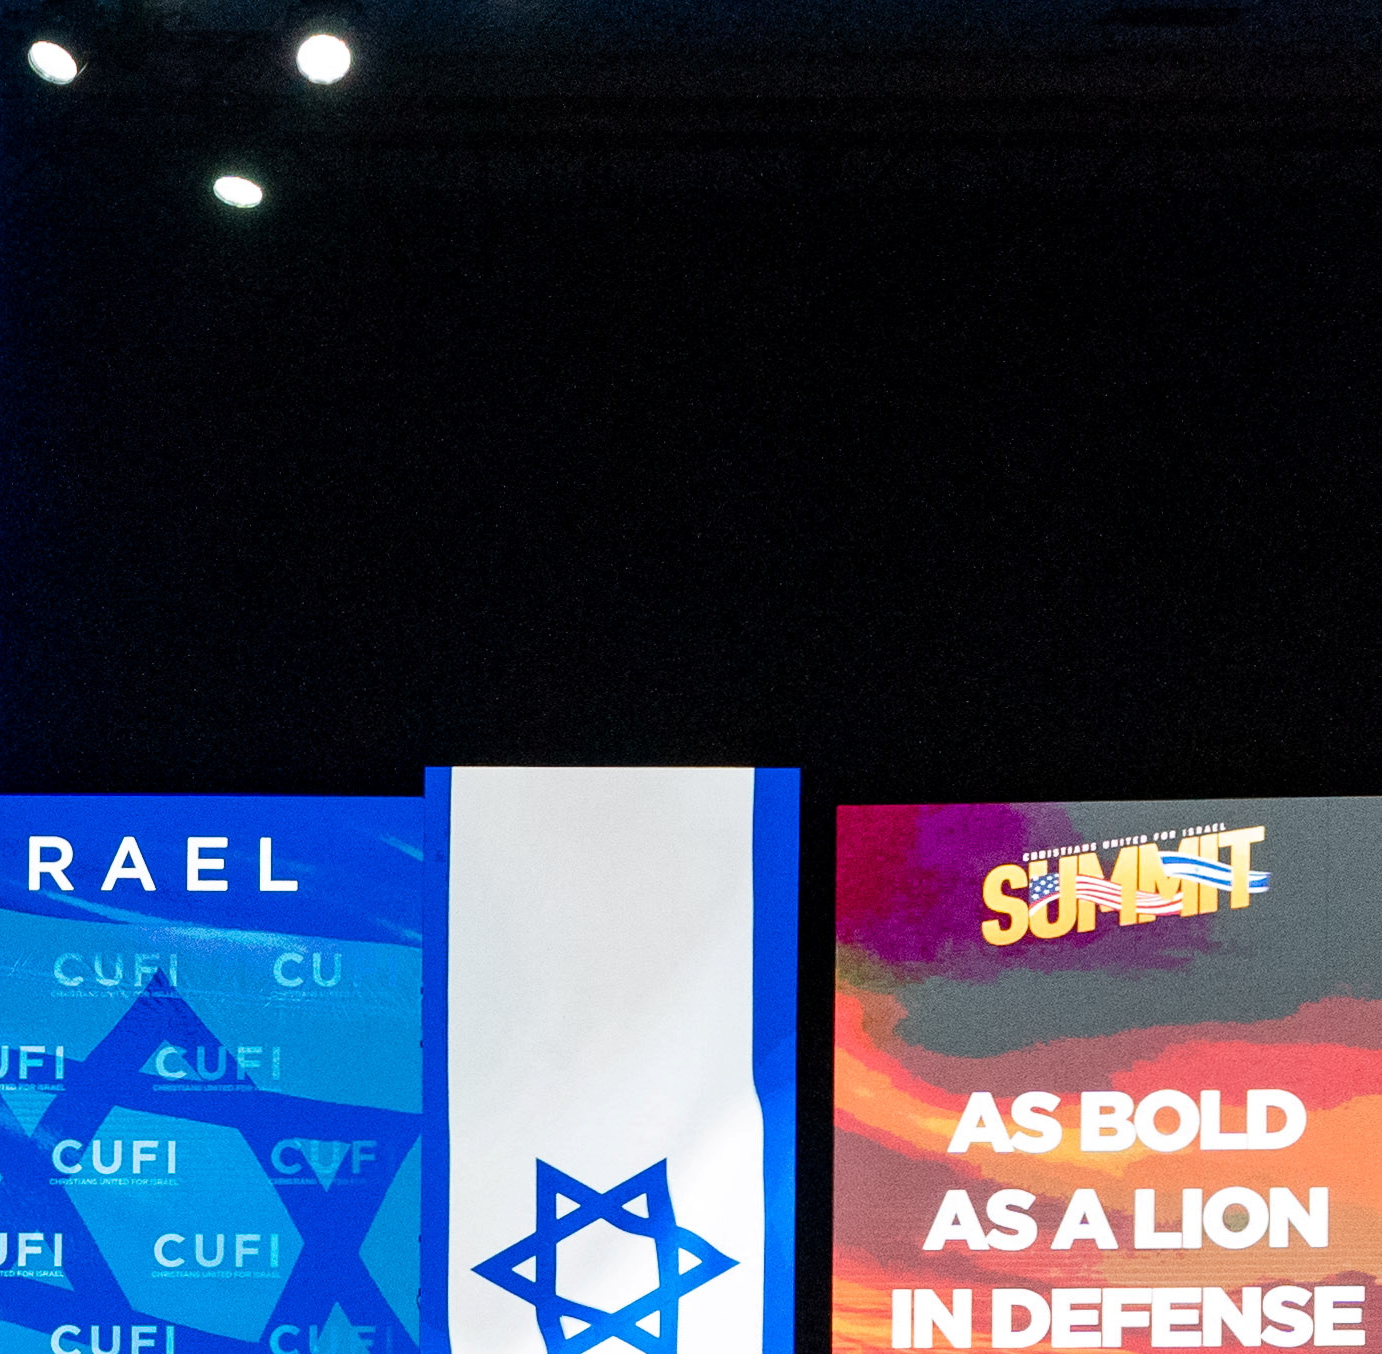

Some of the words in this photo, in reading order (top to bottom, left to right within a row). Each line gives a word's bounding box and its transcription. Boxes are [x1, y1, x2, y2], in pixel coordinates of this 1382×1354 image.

[1022, 842, 1097, 862] CHRISTIANS
[1102, 834, 1148, 849] UNITED
[1153, 829, 1177, 842] FOR
[1182, 822, 1227, 837] ISRAEL
[981, 826, 1265, 946] SUMMIT
[53, 954, 177, 989] CUFI
[155, 1046, 280, 1081] CUFI
[947, 1090, 1062, 1153] AS
[1080, 1089, 1307, 1152] BOLD
[53, 1139, 175, 1174] CUFI
[922, 1189, 1037, 1251] AS
[1051, 1188, 1118, 1250] A
[1133, 1187, 1329, 1250] LION
[153, 1233, 277, 1268] CUFI
[891, 1288, 972, 1349] IN
[991, 1285, 1366, 1348] DEFENSE
